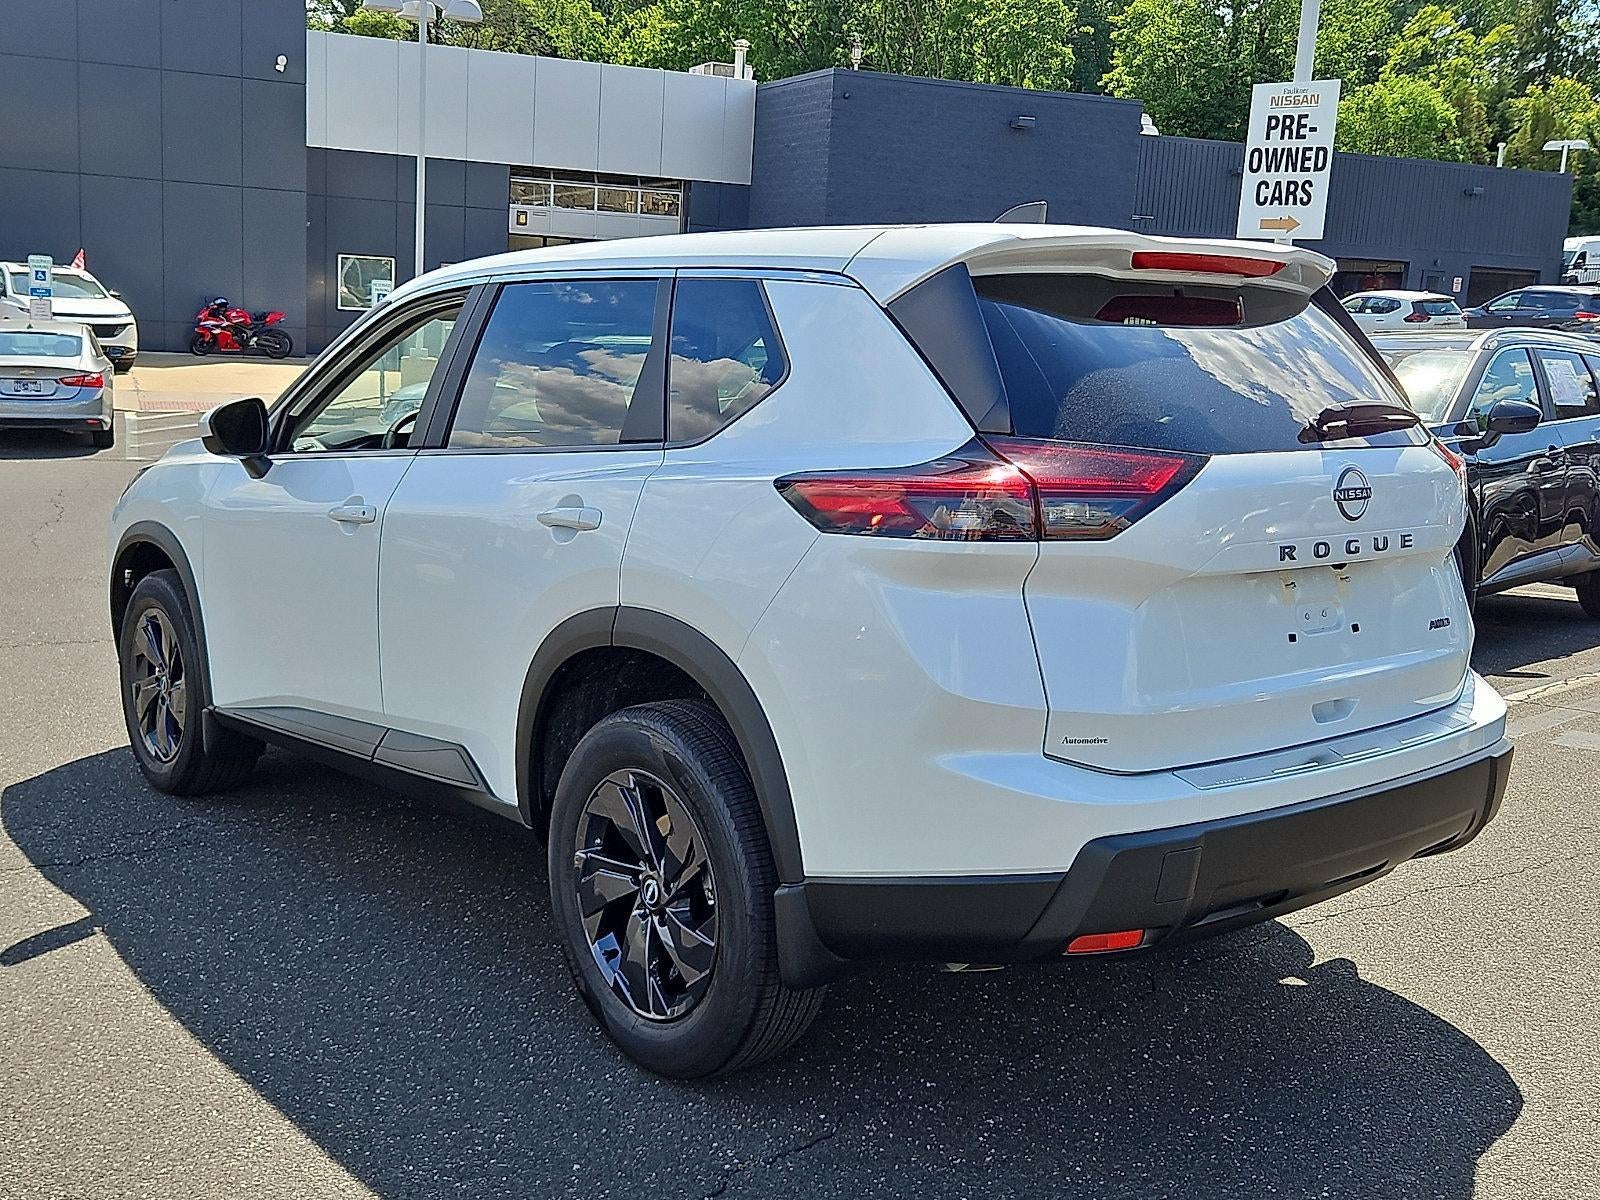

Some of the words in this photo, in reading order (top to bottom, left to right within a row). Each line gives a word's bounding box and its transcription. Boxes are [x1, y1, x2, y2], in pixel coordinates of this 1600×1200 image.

[1270, 94, 1320, 107] NISSAN
[1265, 114, 1318, 140] PRE-
[1248, 146, 1328, 173] OWNED
[1255, 180, 1314, 206] CARS
[1335, 488, 1372, 500] NISSAN
[1279, 533, 1414, 561] ROGUE
[1061, 736, 1108, 744] Automotive
